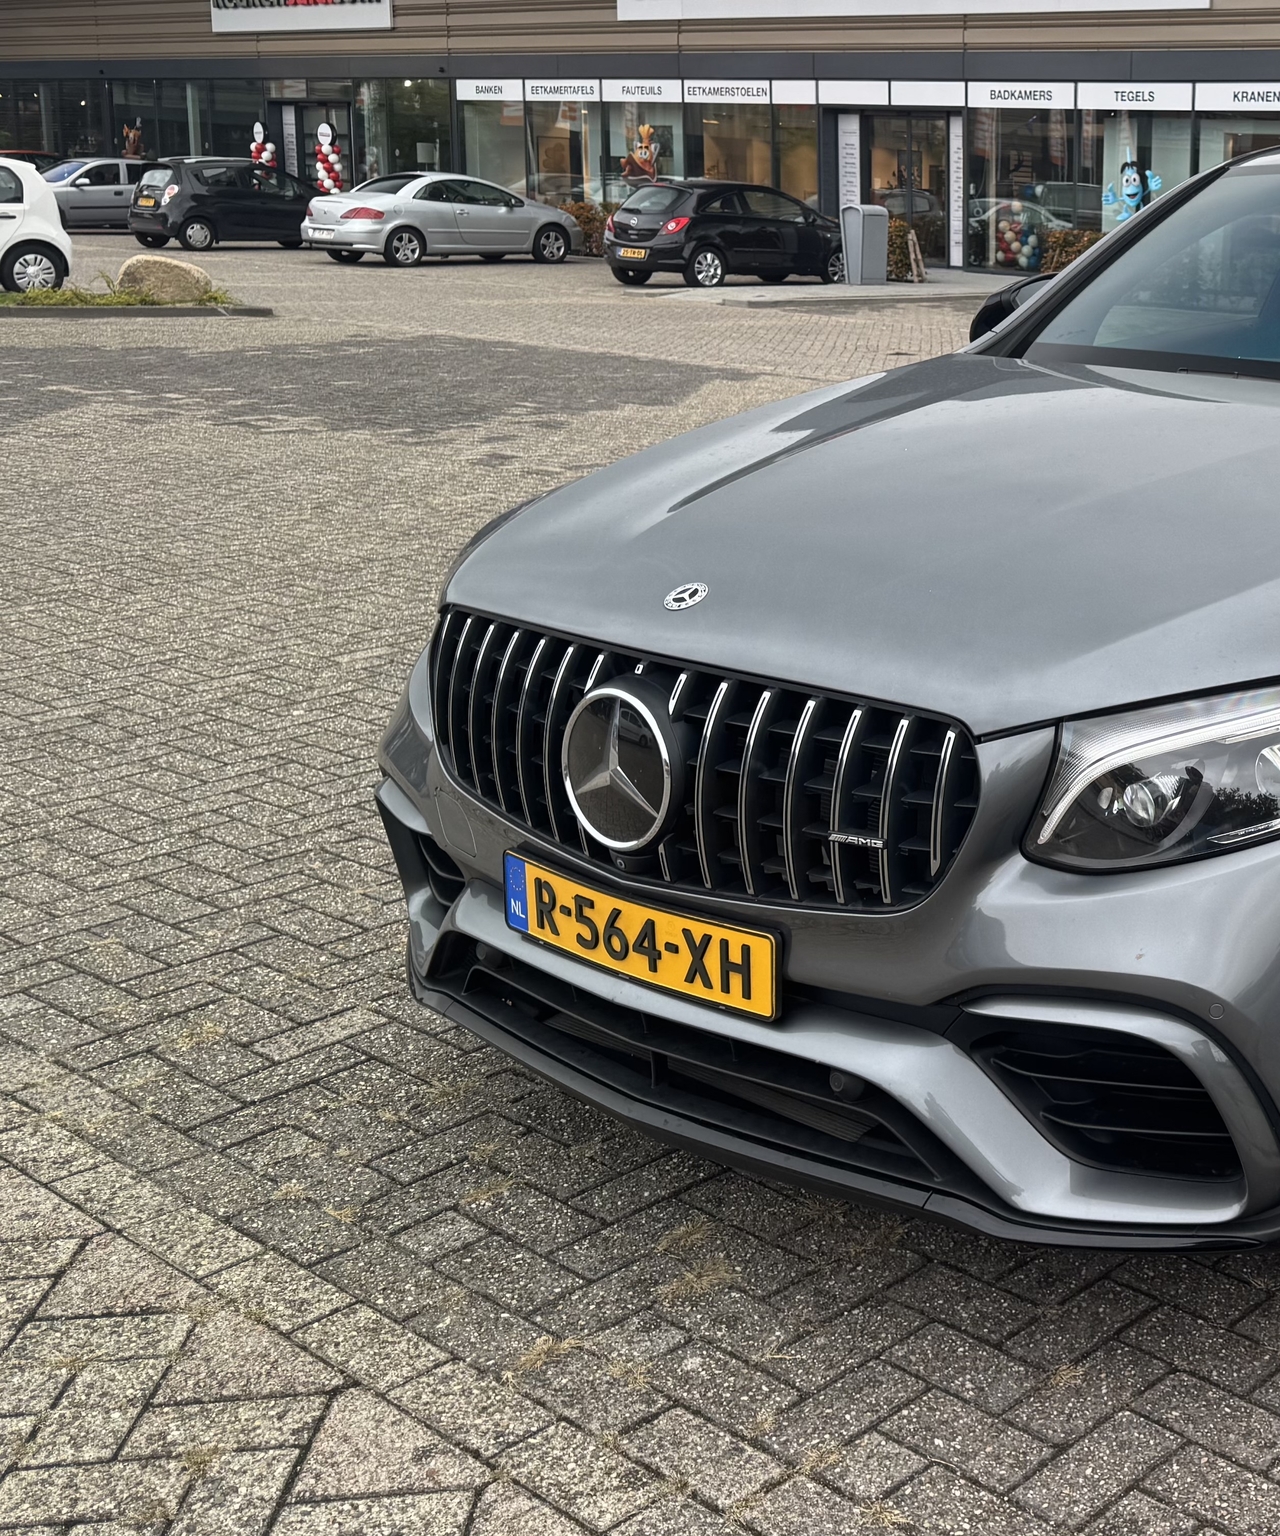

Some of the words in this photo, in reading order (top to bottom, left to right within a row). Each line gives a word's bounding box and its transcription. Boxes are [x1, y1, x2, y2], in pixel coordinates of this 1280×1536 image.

[475, 85, 503, 95] BANKEN
[530, 86, 595, 96] EETKAMERTAFELS
[621, 86, 663, 96] FAUTEUILS
[686, 86, 768, 98] EETKAMERSTOELEN
[989, 89, 1053, 102] BADKAMERS
[1113, 91, 1155, 102] TEGELS
[846, 835, 884, 849] AMG
[510, 897, 527, 919] NL
[534, 876, 752, 1001] R-564-XH
